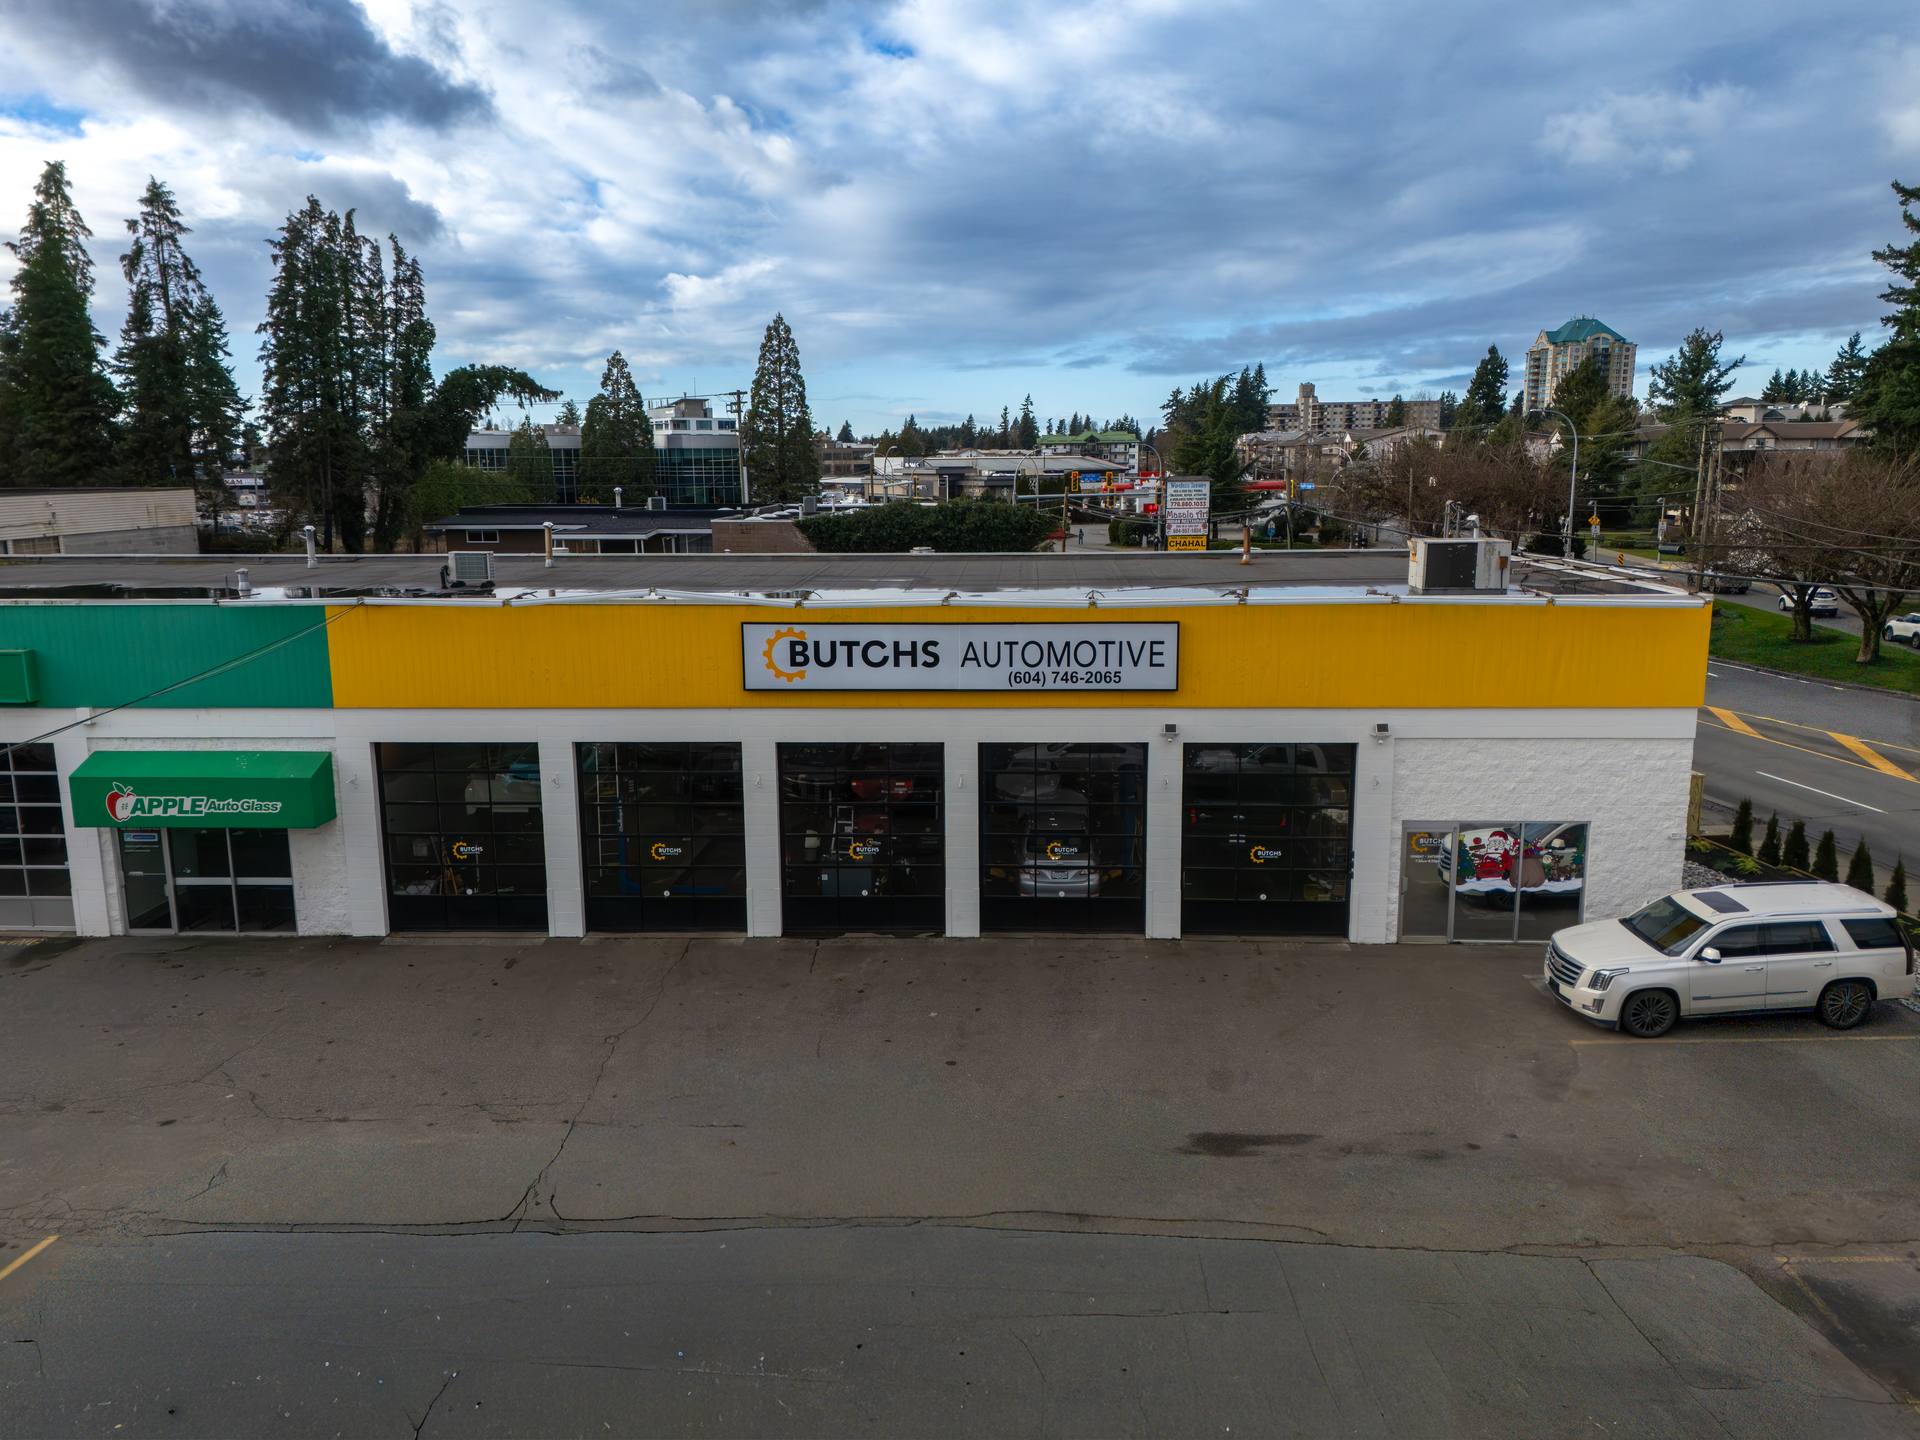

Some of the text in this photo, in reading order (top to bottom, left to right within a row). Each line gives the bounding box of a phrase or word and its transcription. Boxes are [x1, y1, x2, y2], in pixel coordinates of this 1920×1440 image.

[789, 639, 1166, 668] BUTCHS AUTOMOTIVE
[1008, 670, 1122, 687] (604) 746-2065
[130, 797, 206, 816] APPLE
